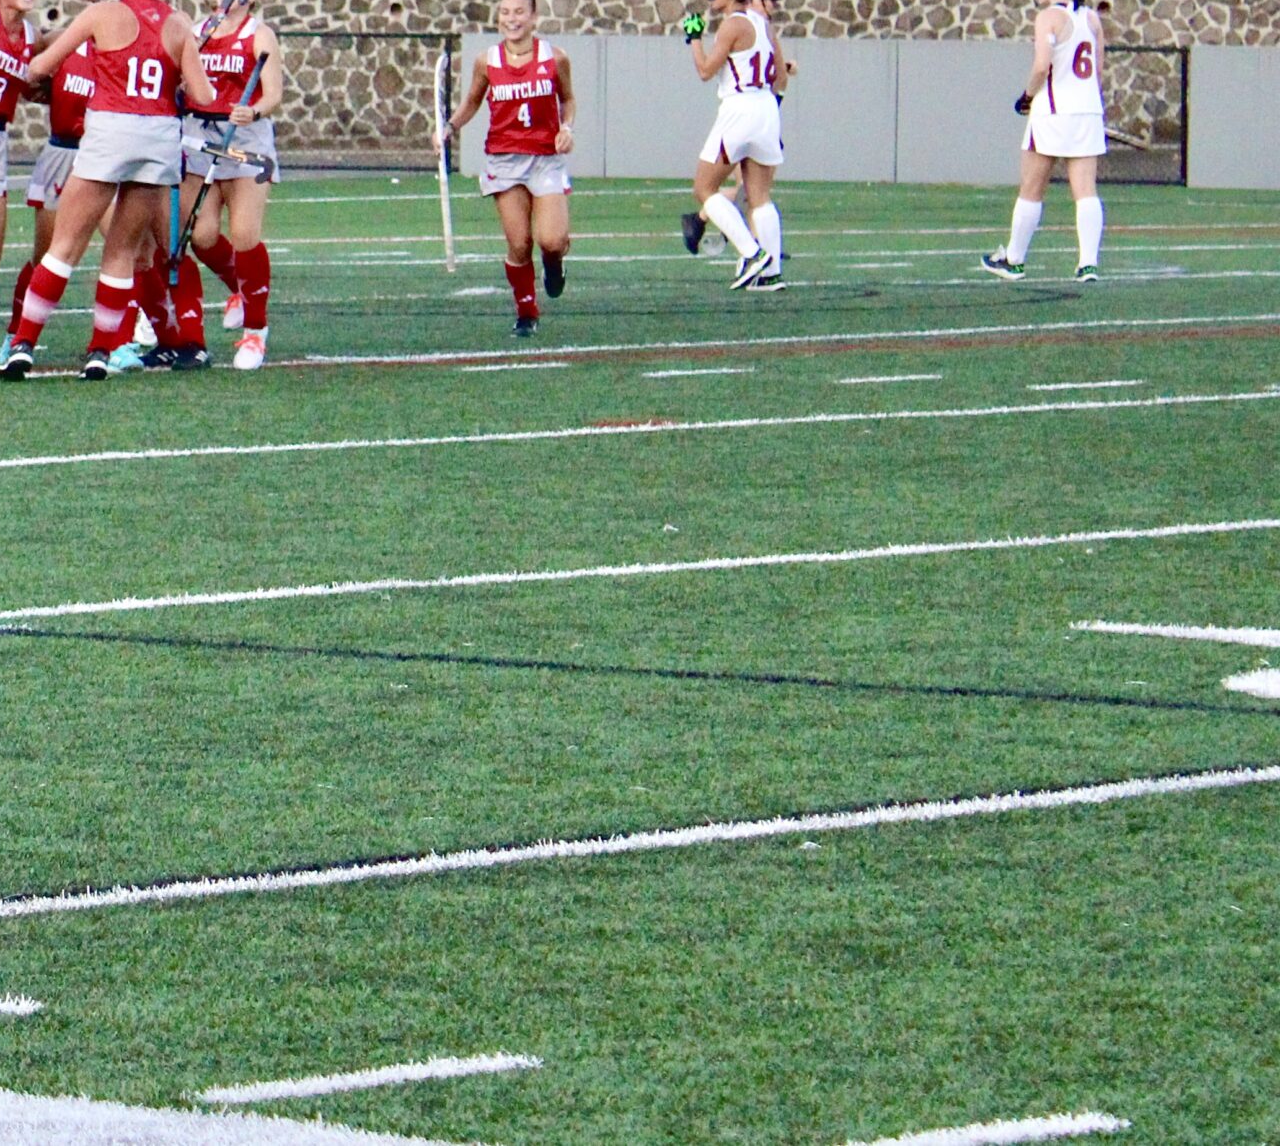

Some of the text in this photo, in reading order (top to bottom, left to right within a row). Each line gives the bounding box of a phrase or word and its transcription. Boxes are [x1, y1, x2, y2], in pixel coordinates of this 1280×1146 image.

[1072, 40, 1093, 80] 6
[126, 56, 163, 100] 19
[491, 78, 553, 102] MONTCLAIR
[517, 102, 532, 128] 4
